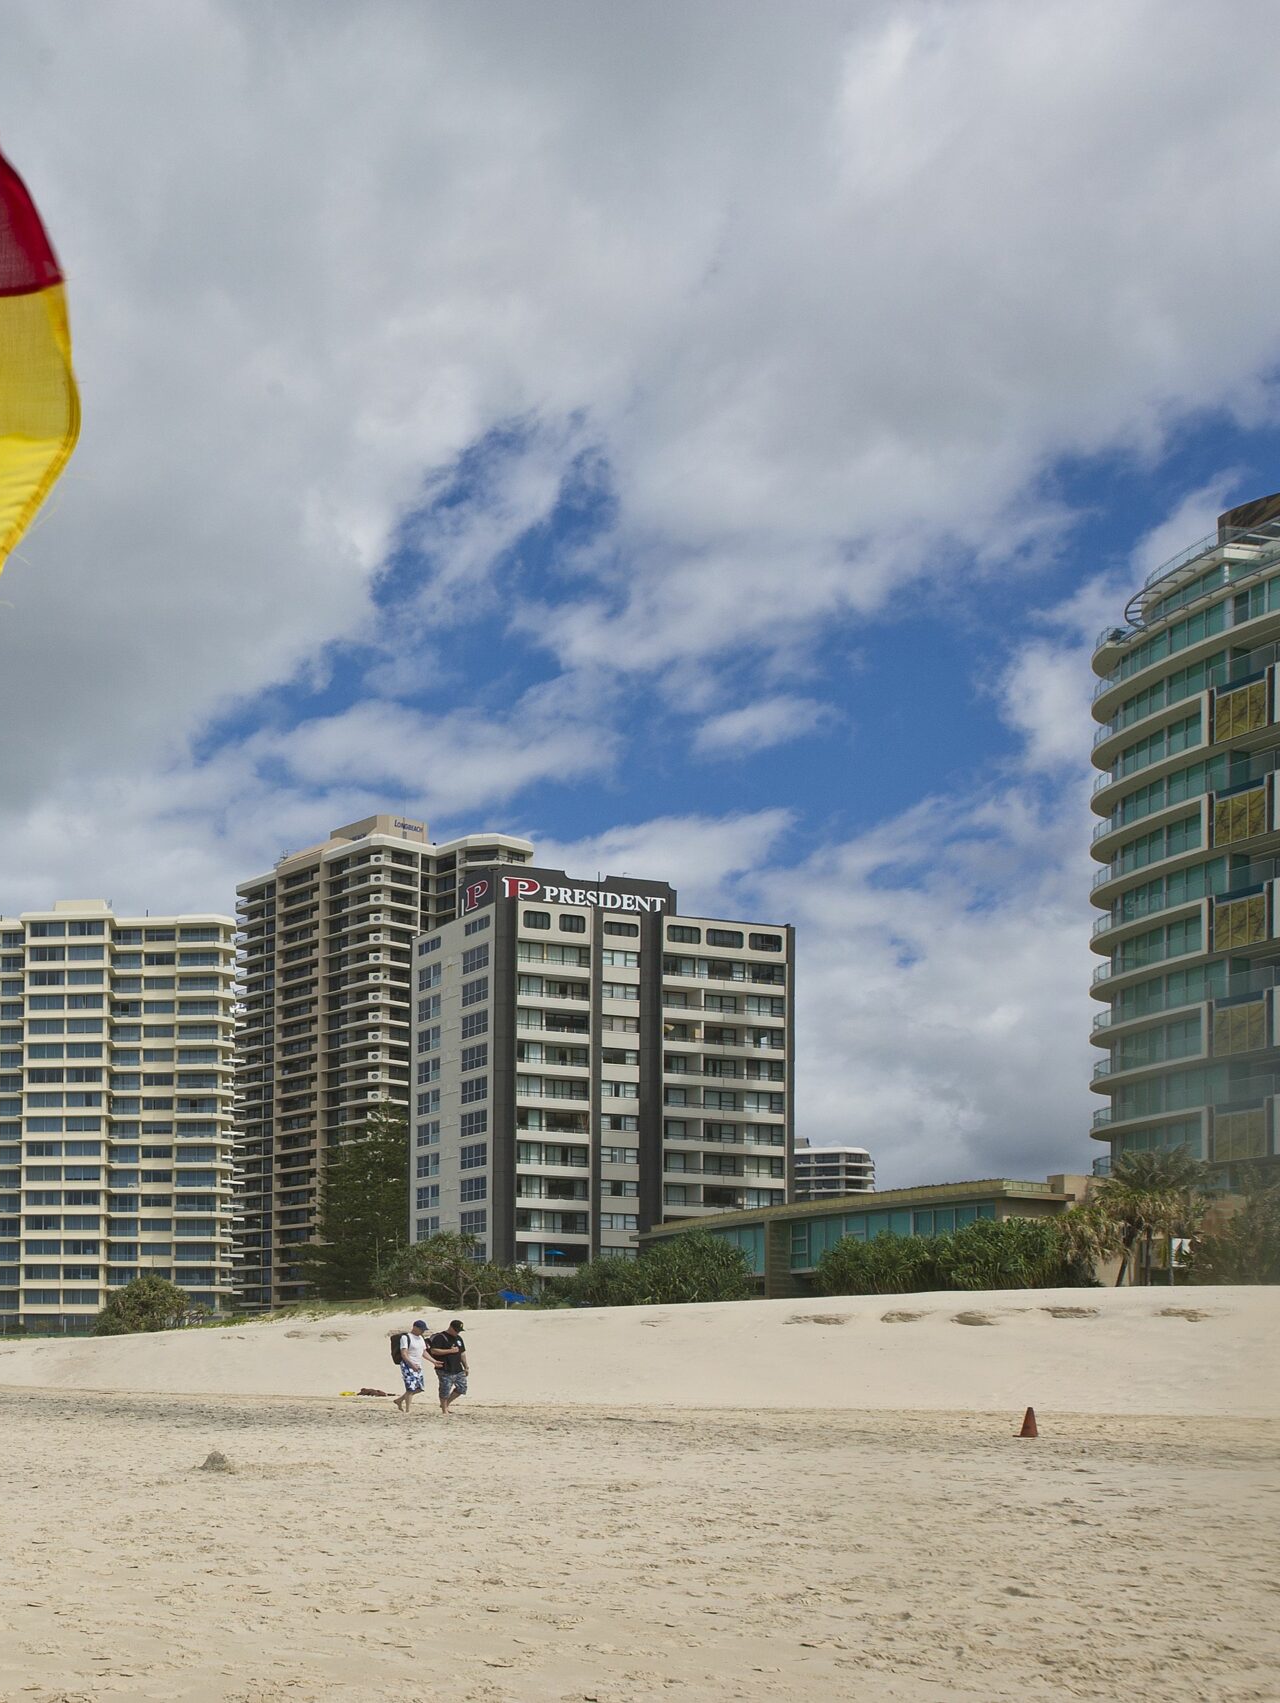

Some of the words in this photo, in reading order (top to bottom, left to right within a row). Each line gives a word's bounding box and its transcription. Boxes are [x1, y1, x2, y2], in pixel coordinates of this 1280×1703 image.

[466, 880, 489, 911] P
[501, 876, 540, 901] P
[544, 885, 666, 912] PRESIDENT
